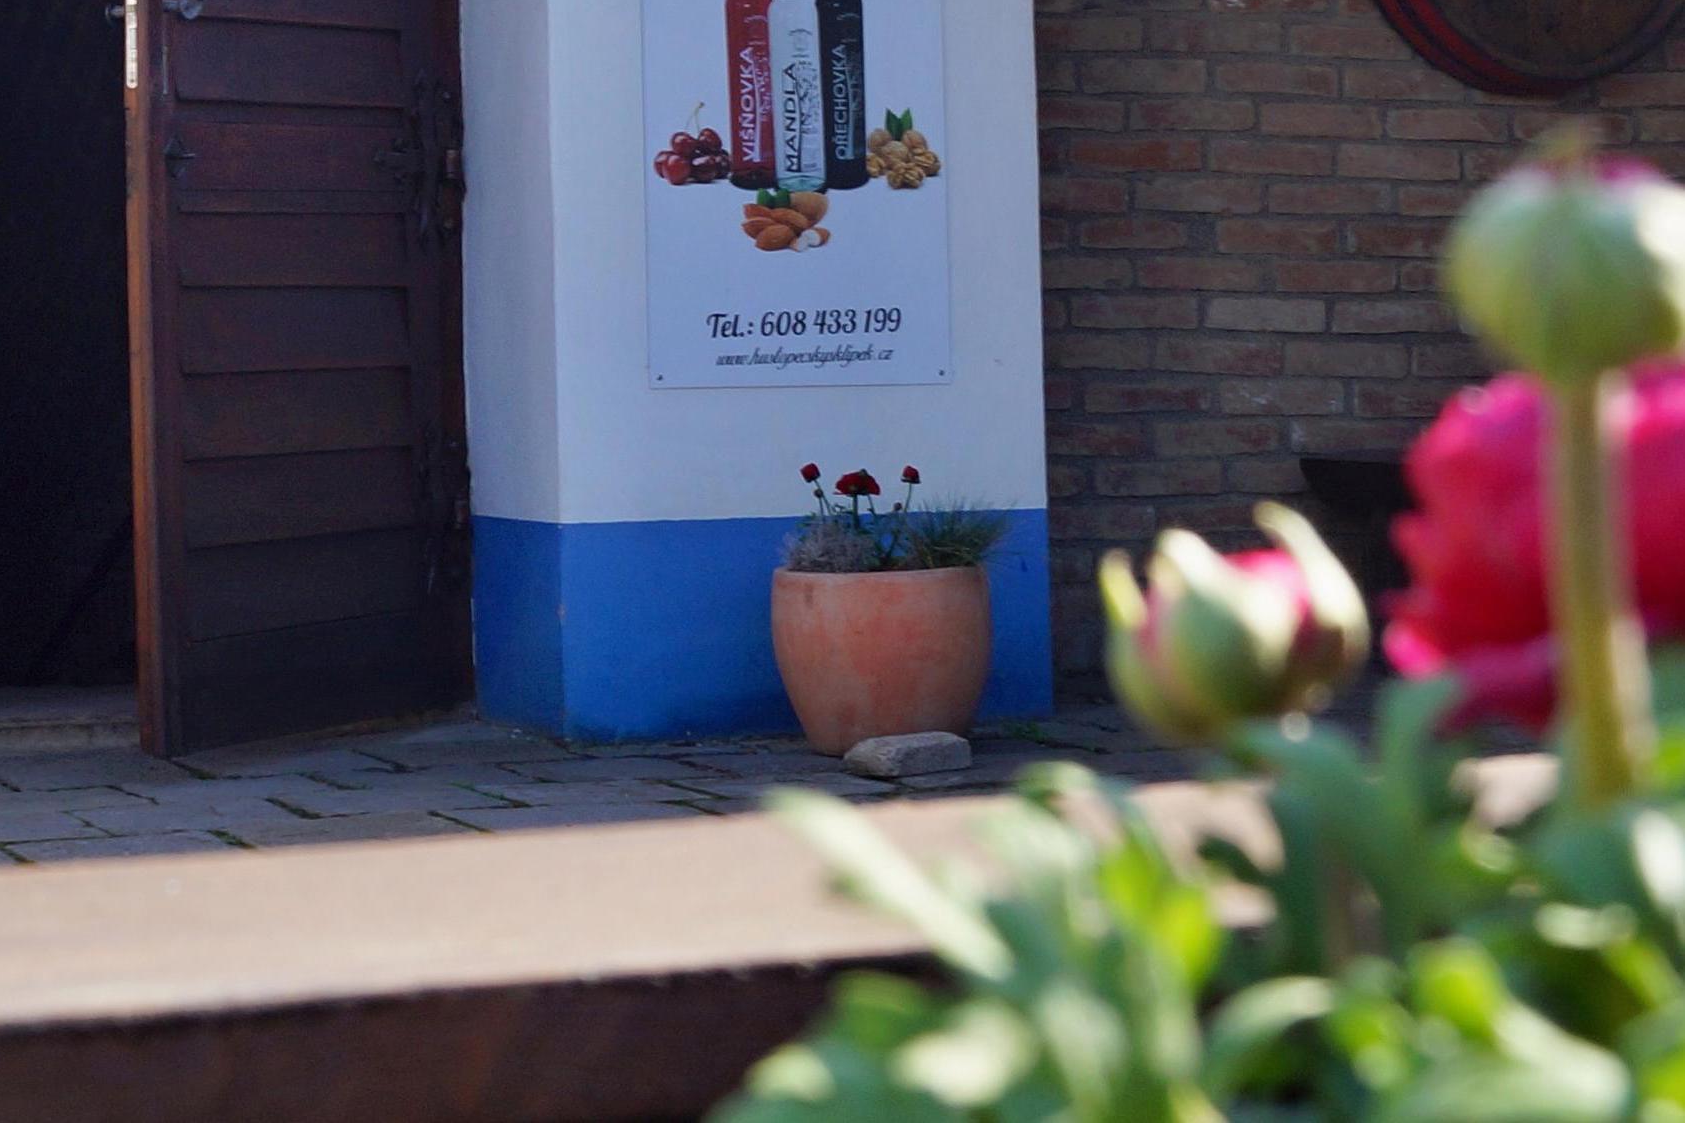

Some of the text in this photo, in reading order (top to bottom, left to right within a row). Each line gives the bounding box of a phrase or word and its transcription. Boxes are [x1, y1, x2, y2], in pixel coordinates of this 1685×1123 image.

[738, 46, 756, 162] VIŠŇOVKA
[782, 63, 801, 173] MANDLA
[831, 44, 848, 160] OŘECHOVKA
[706, 307, 902, 338] Tel.: 608 433 199
